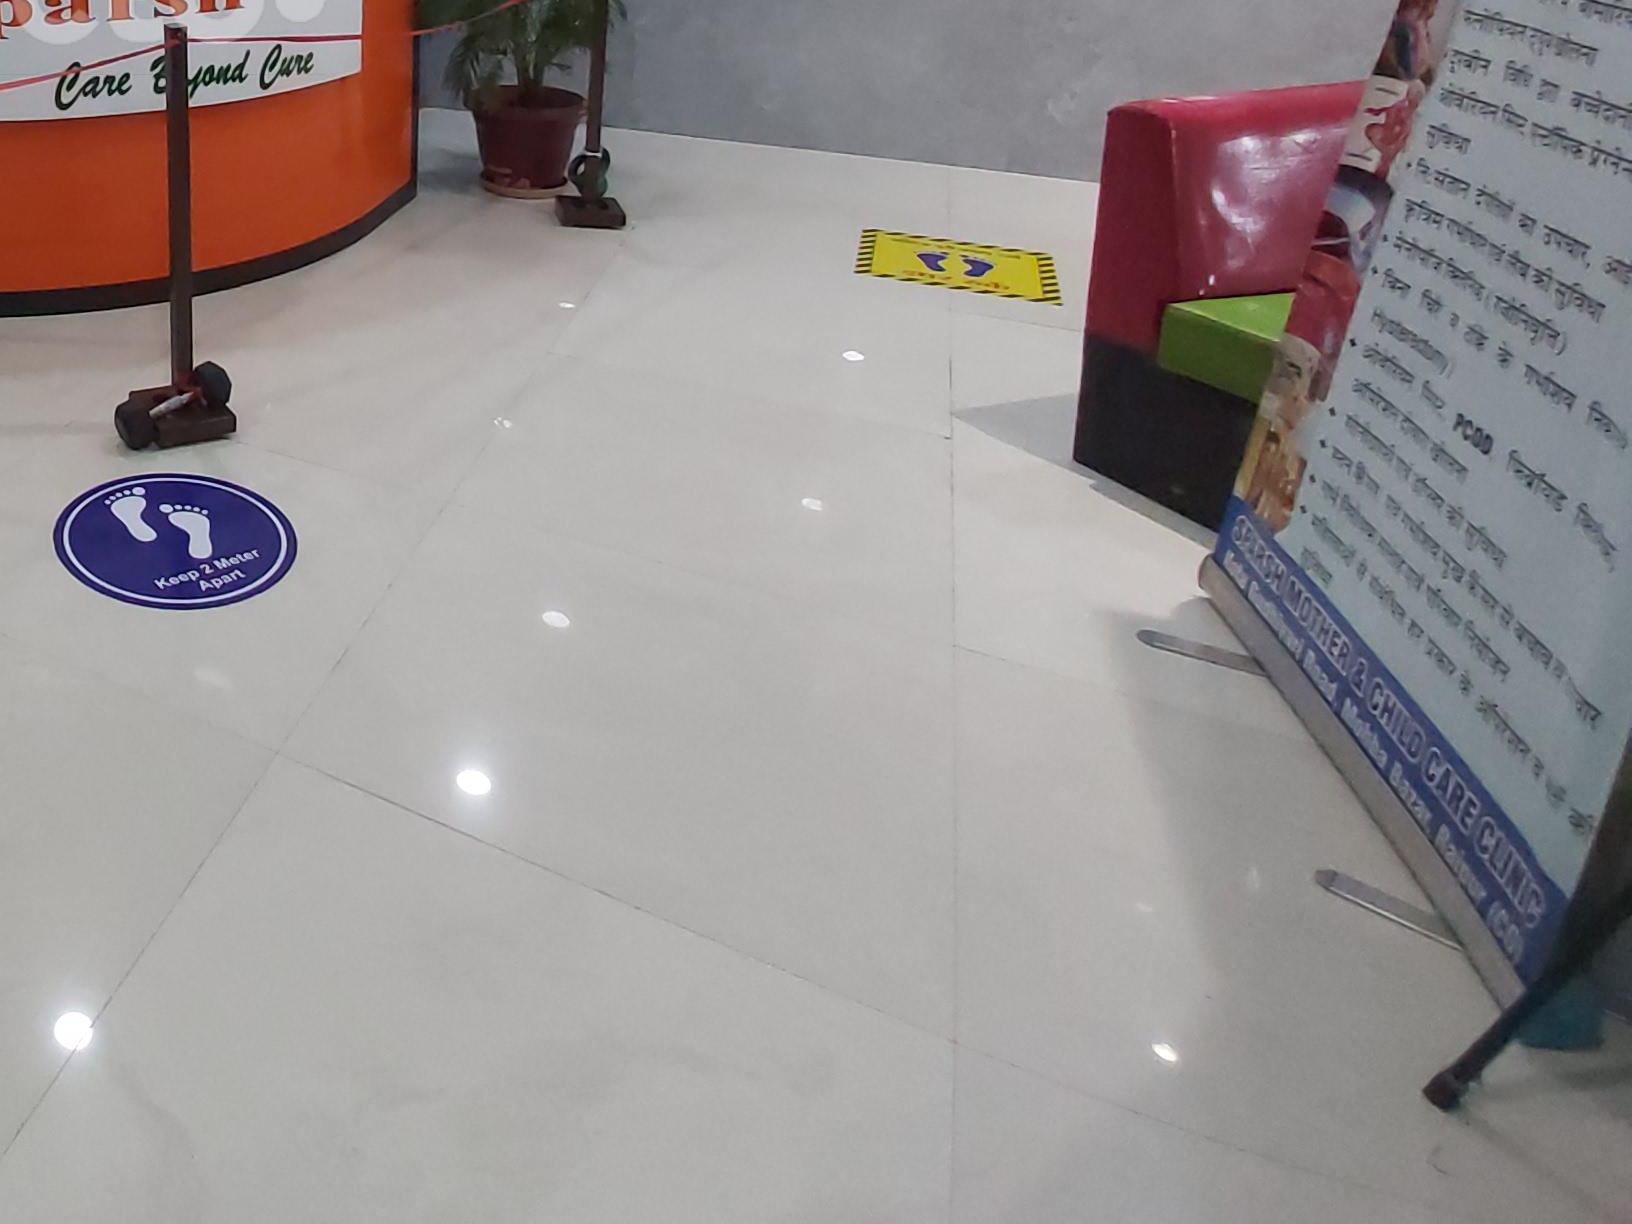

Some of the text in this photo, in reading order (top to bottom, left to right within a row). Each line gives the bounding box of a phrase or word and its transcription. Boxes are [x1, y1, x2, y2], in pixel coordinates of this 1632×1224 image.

[54, 44, 314, 111] Care Byond Cure
[154, 548, 261, 590] Keep 2 Meter
[199, 568, 247, 592] Apart
[1284, 575, 1353, 676] MOTHER
[1368, 678, 1426, 763] CHILD
[1422, 746, 1481, 836] CARE
[1473, 816, 1546, 928] CLINIC
